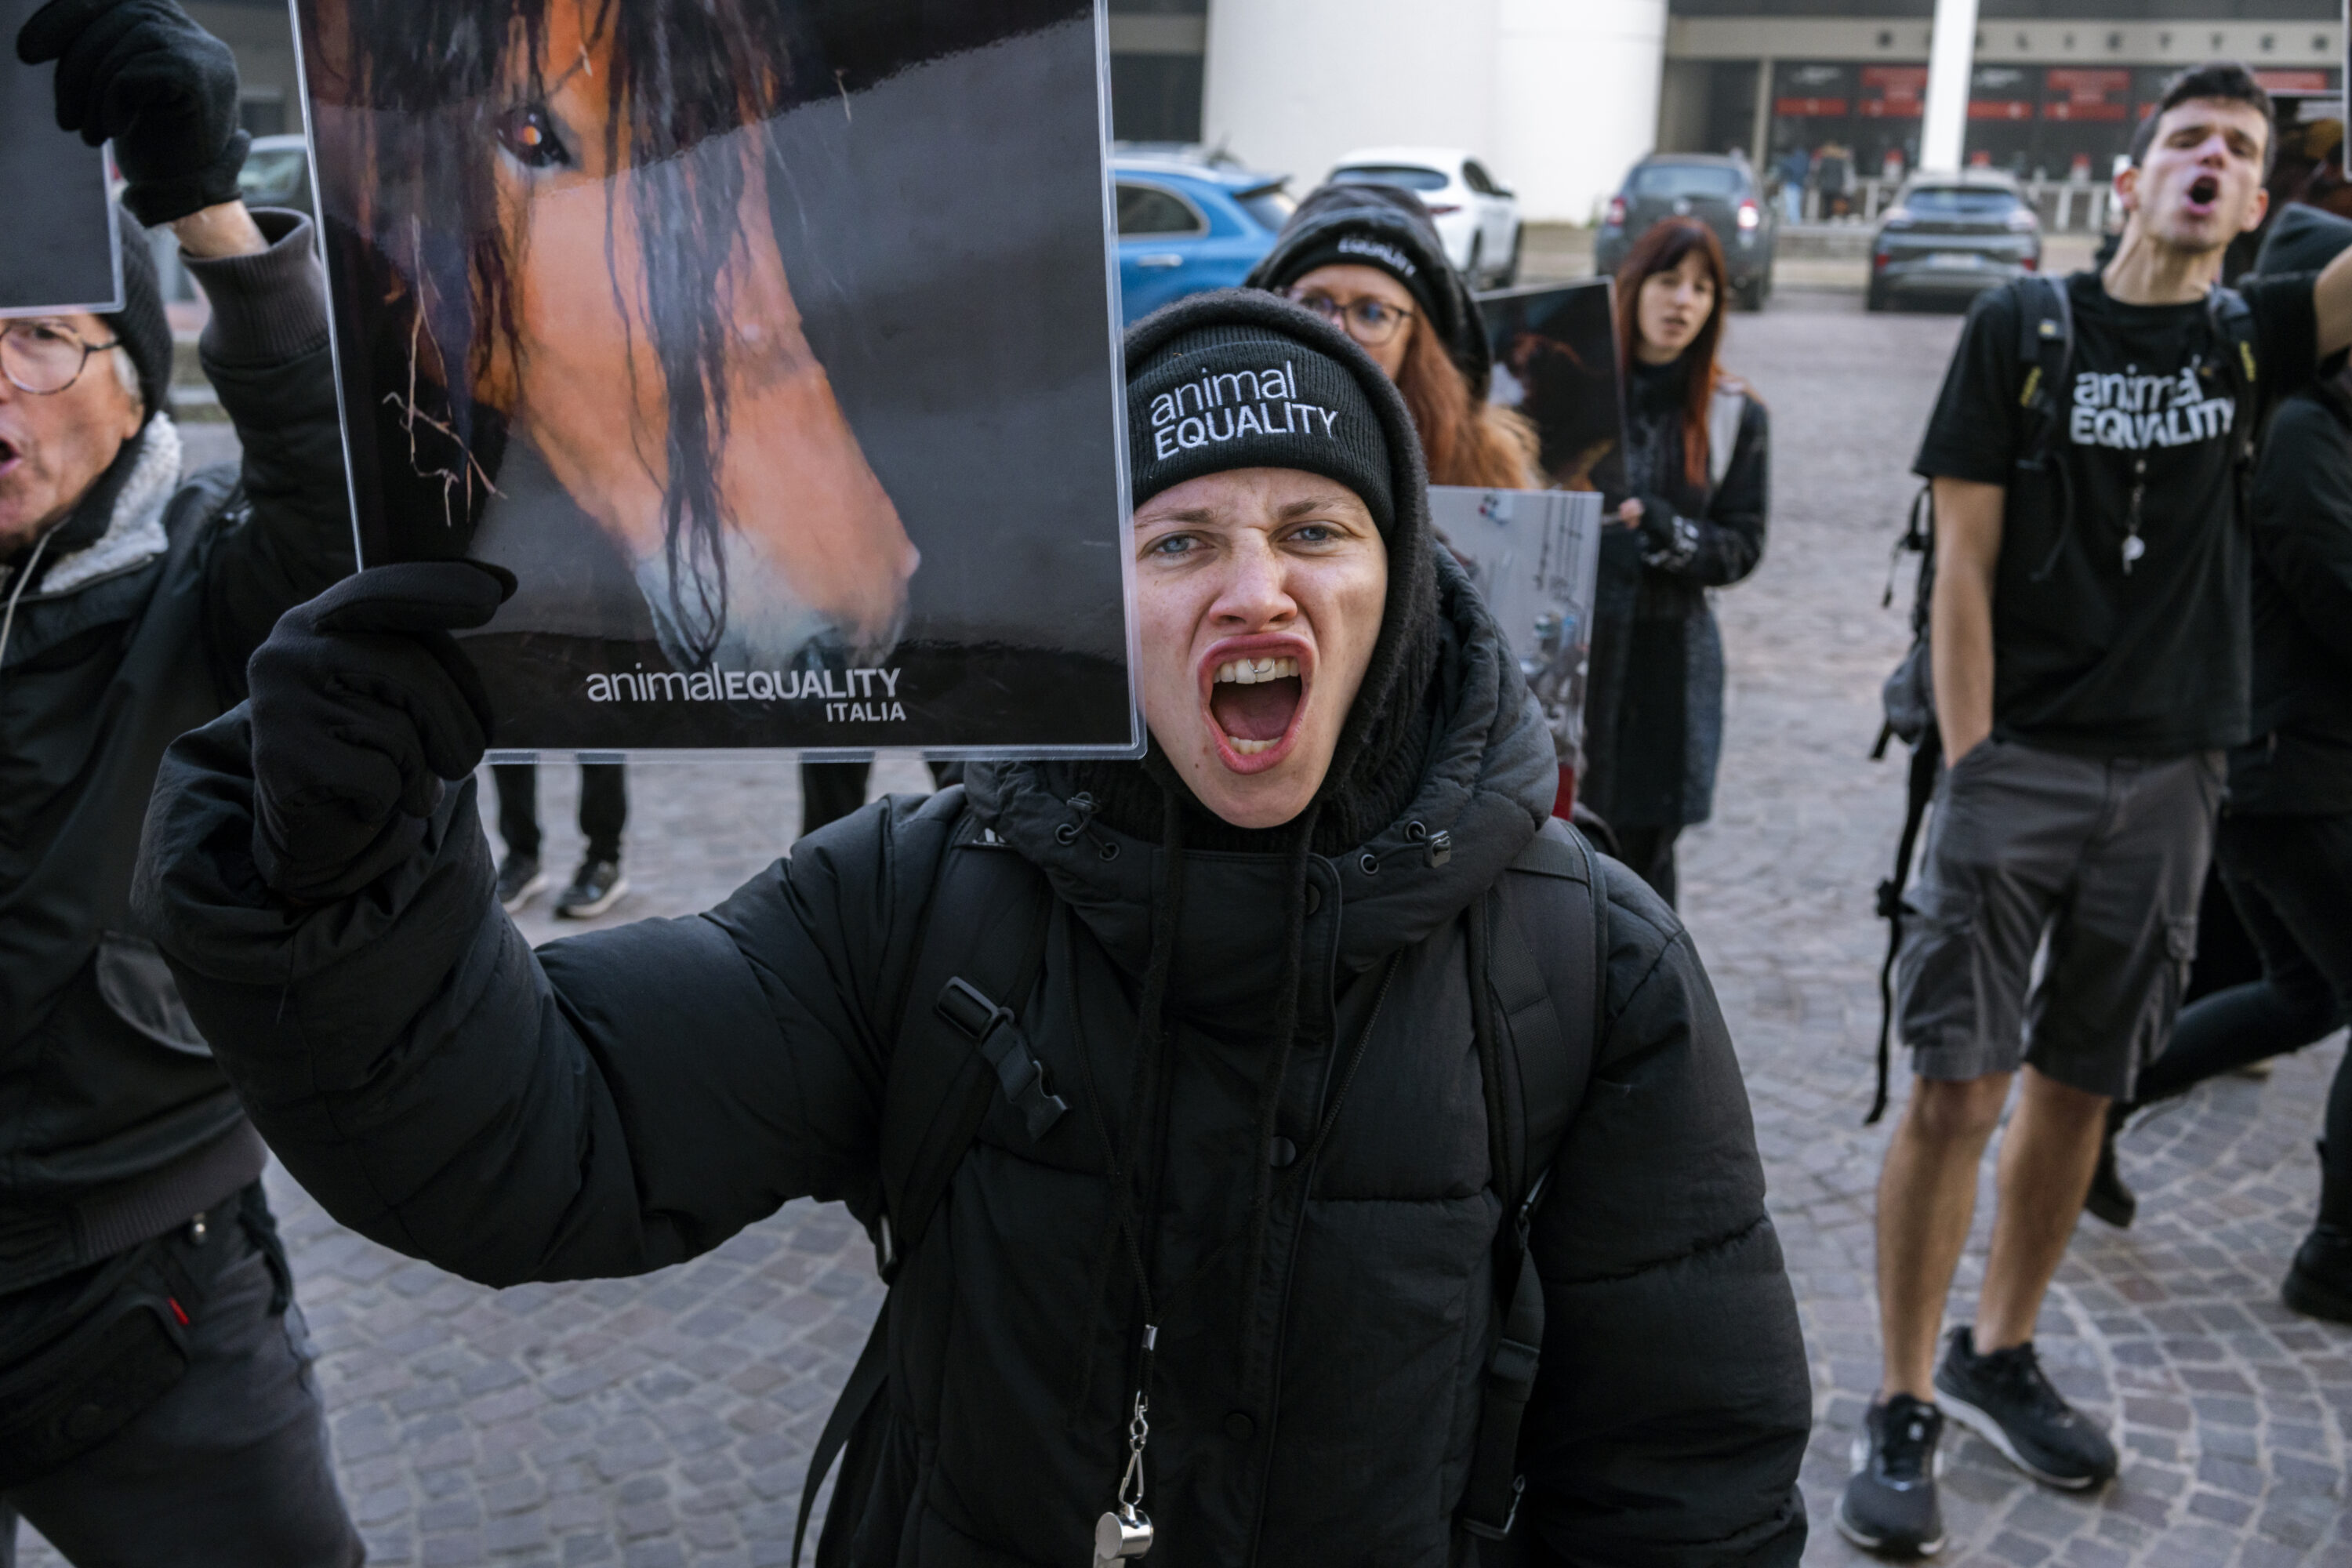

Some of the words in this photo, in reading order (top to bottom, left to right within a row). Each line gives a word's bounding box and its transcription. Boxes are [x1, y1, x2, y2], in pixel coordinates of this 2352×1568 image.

[1150, 360, 1297, 427] animal
[1154, 401, 1338, 460] EQUALITY
[826, 701, 907, 722] ITALIA
